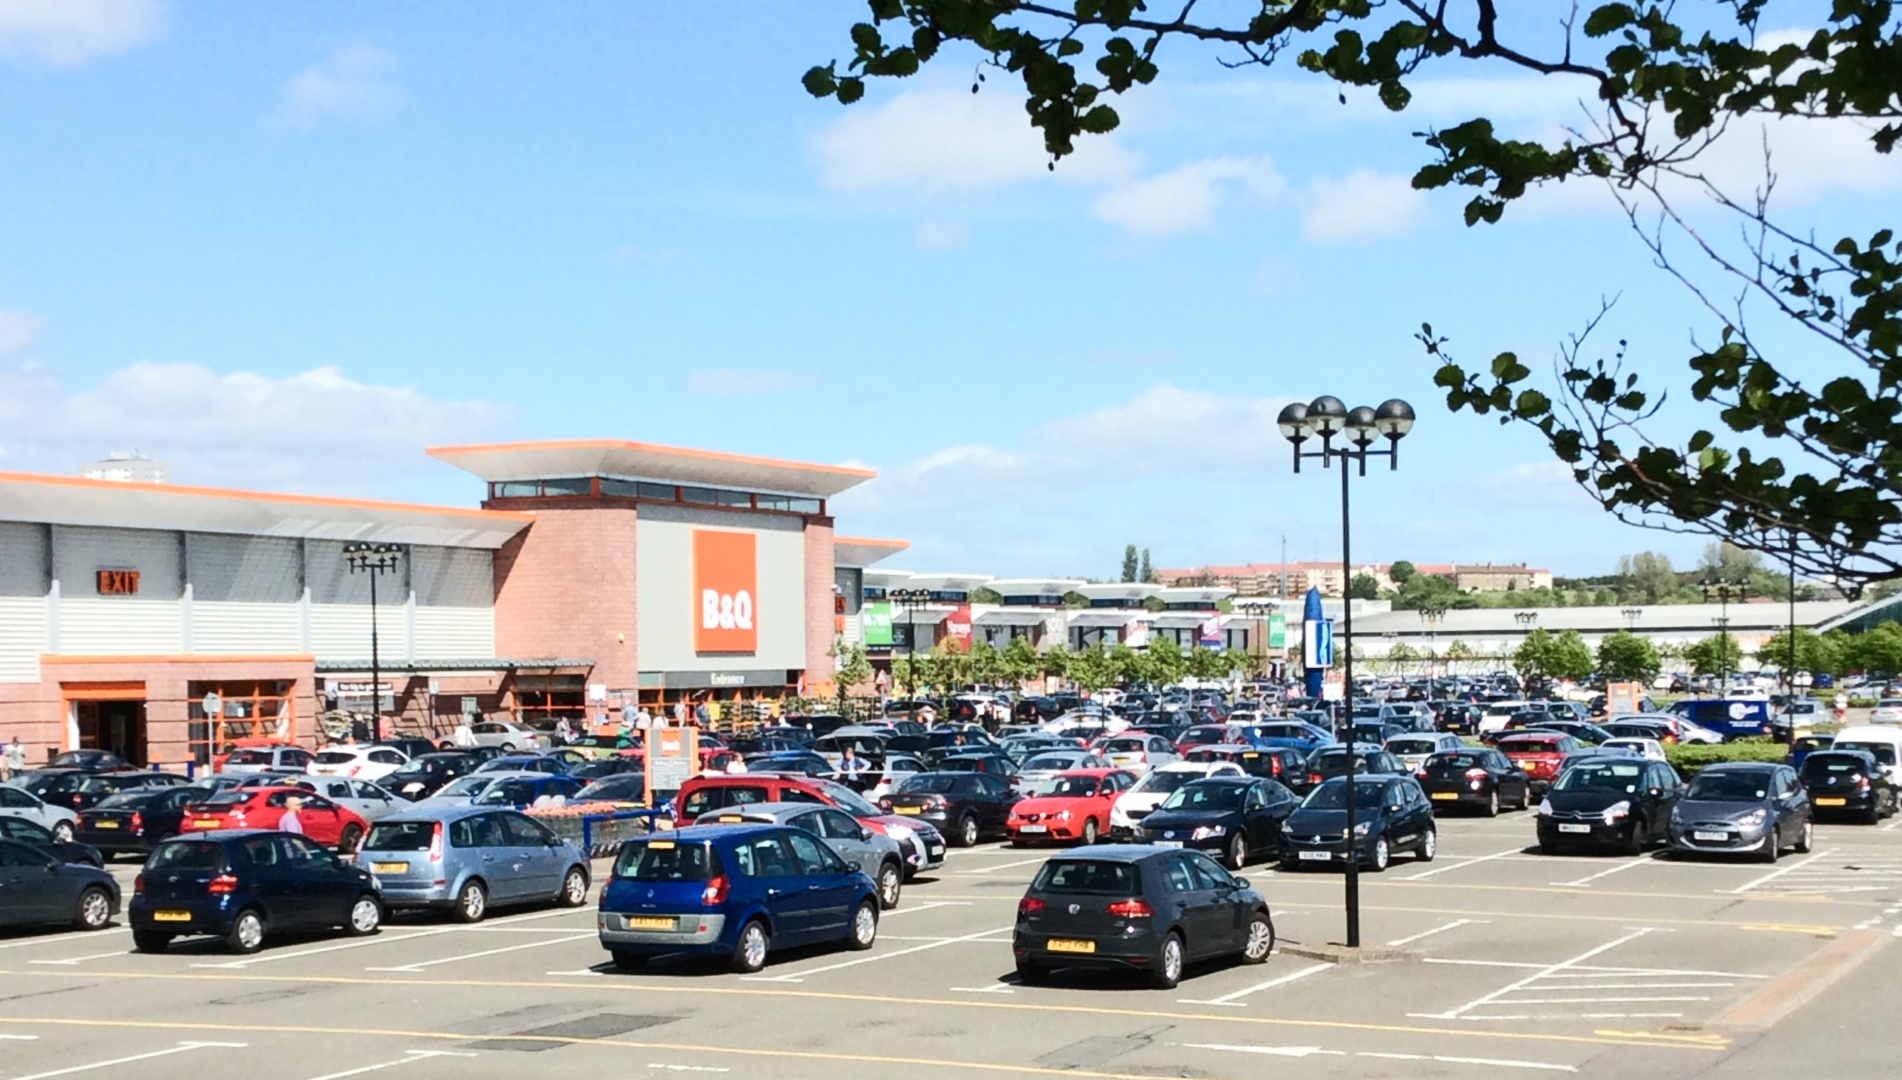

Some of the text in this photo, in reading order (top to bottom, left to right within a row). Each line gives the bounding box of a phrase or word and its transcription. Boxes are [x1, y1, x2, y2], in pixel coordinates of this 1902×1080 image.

[98, 569, 140, 594] EXIT
[702, 589, 753, 630] B&Q
[710, 672, 745, 686] Entrance
